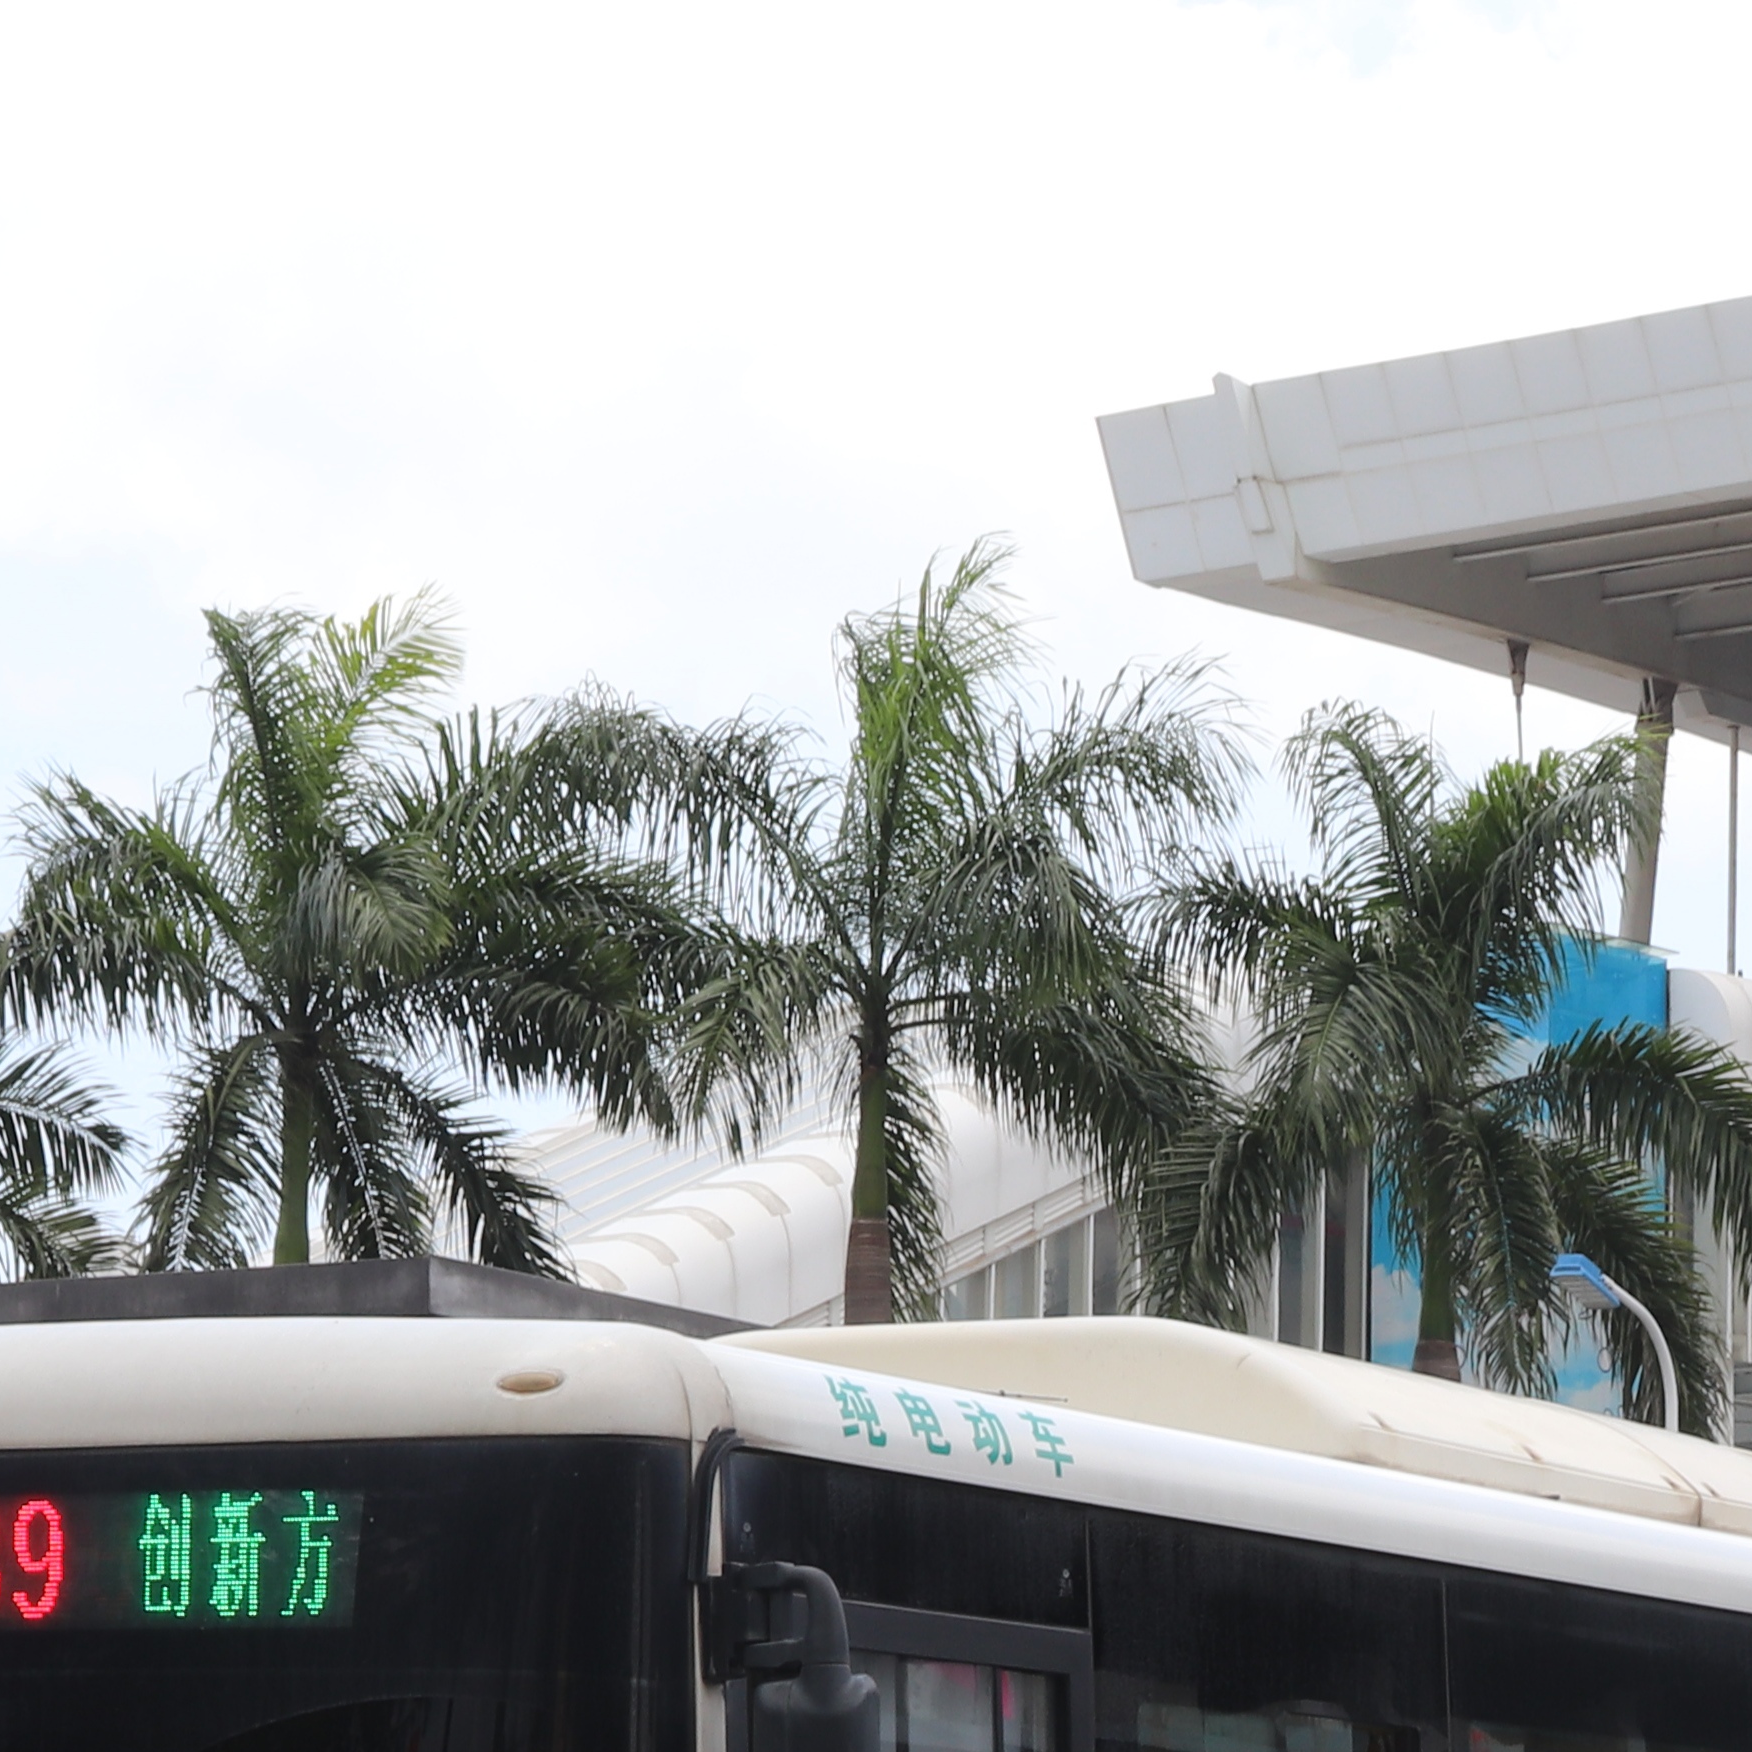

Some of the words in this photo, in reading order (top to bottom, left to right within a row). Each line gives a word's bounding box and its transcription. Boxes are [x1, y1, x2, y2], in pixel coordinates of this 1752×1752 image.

[824, 1374, 1074, 1478] 纯电动车
[139, 1490, 340, 1617] 创新方
